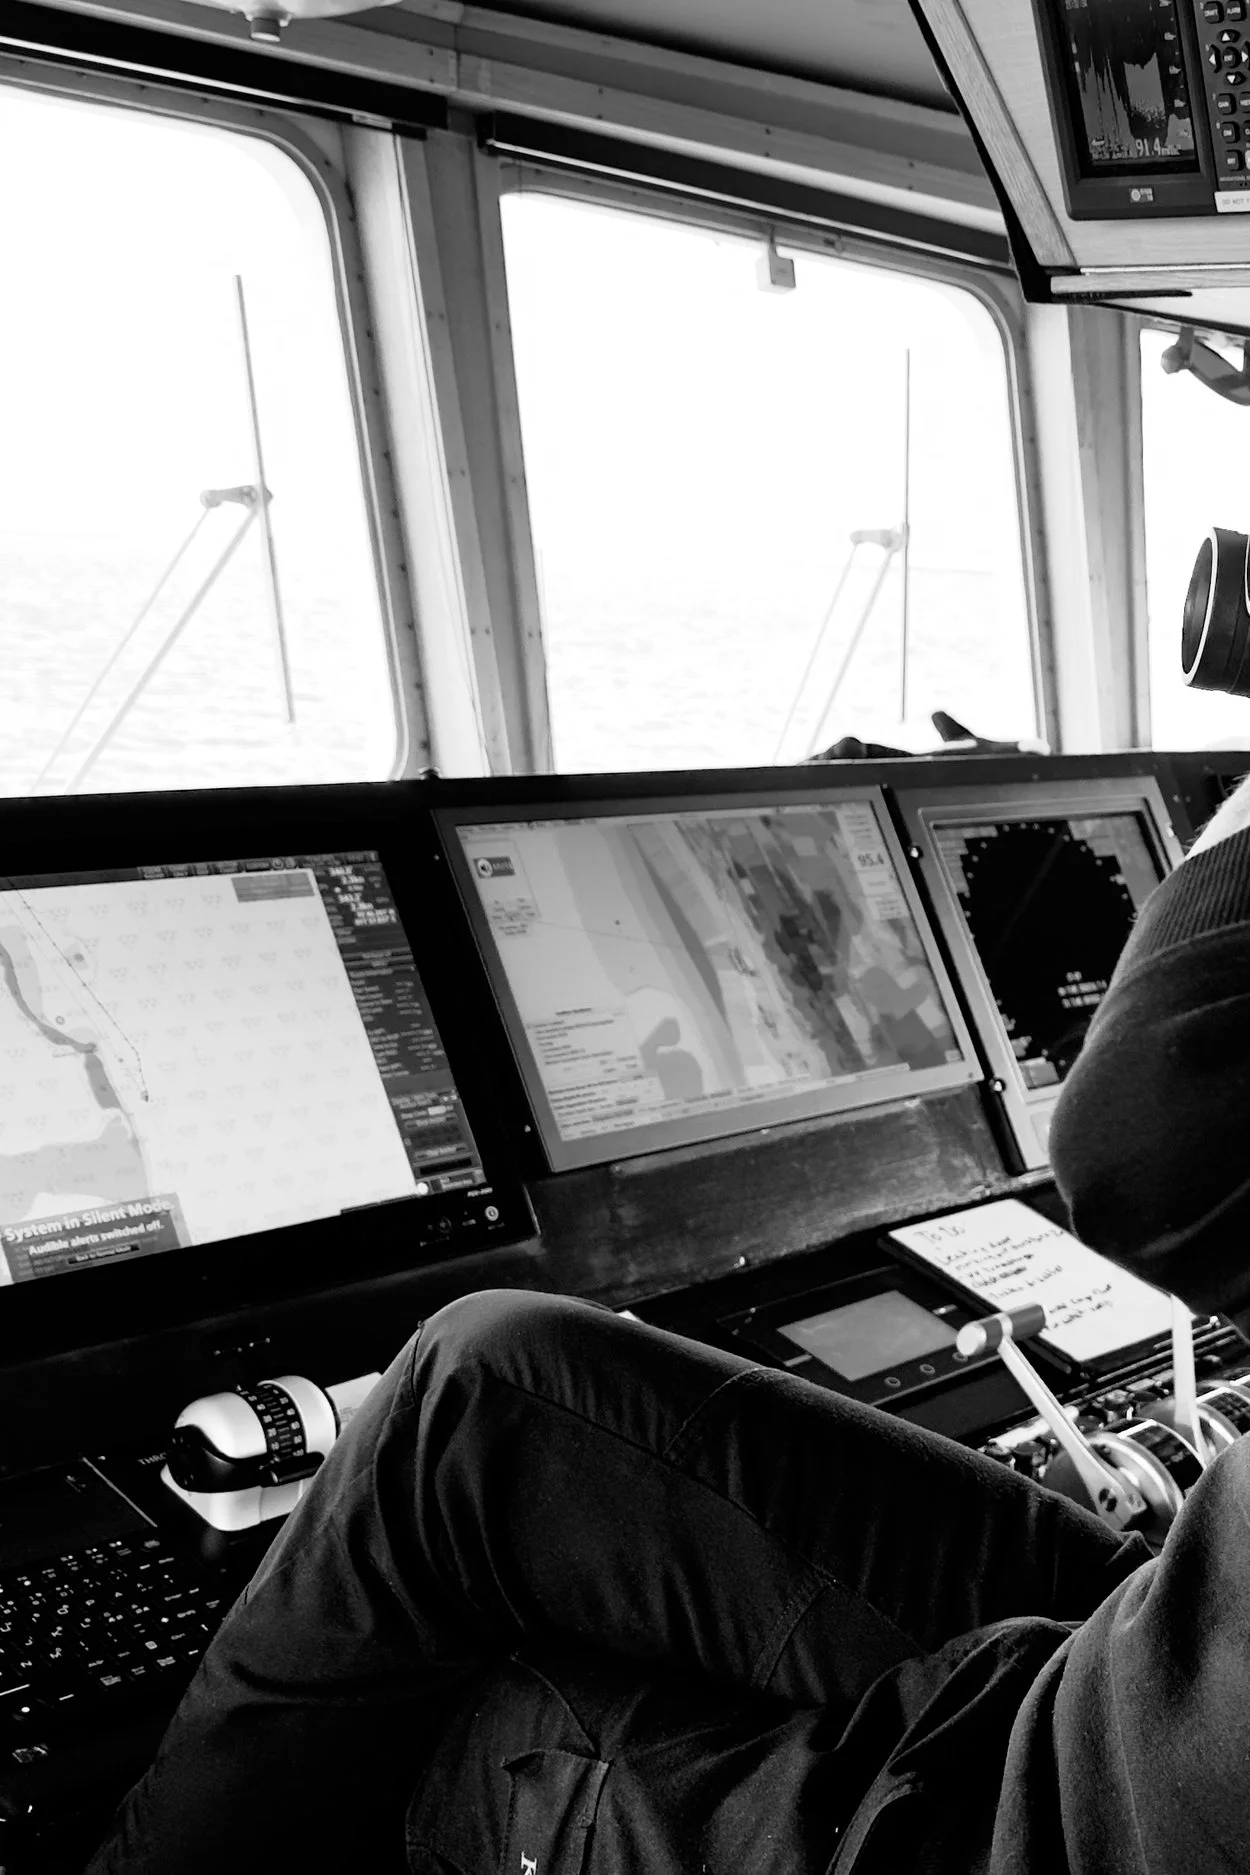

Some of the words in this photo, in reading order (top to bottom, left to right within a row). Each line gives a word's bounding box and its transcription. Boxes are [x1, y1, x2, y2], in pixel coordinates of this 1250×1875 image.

[4, 1221, 63, 1243] System
[65, 1215, 80, 1230] in
[82, 1206, 127, 1227] Silent
[28, 1238, 70, 1255] Audible
[70, 1234, 100, 1248] alerts
[100, 1222, 146, 1242] switched
